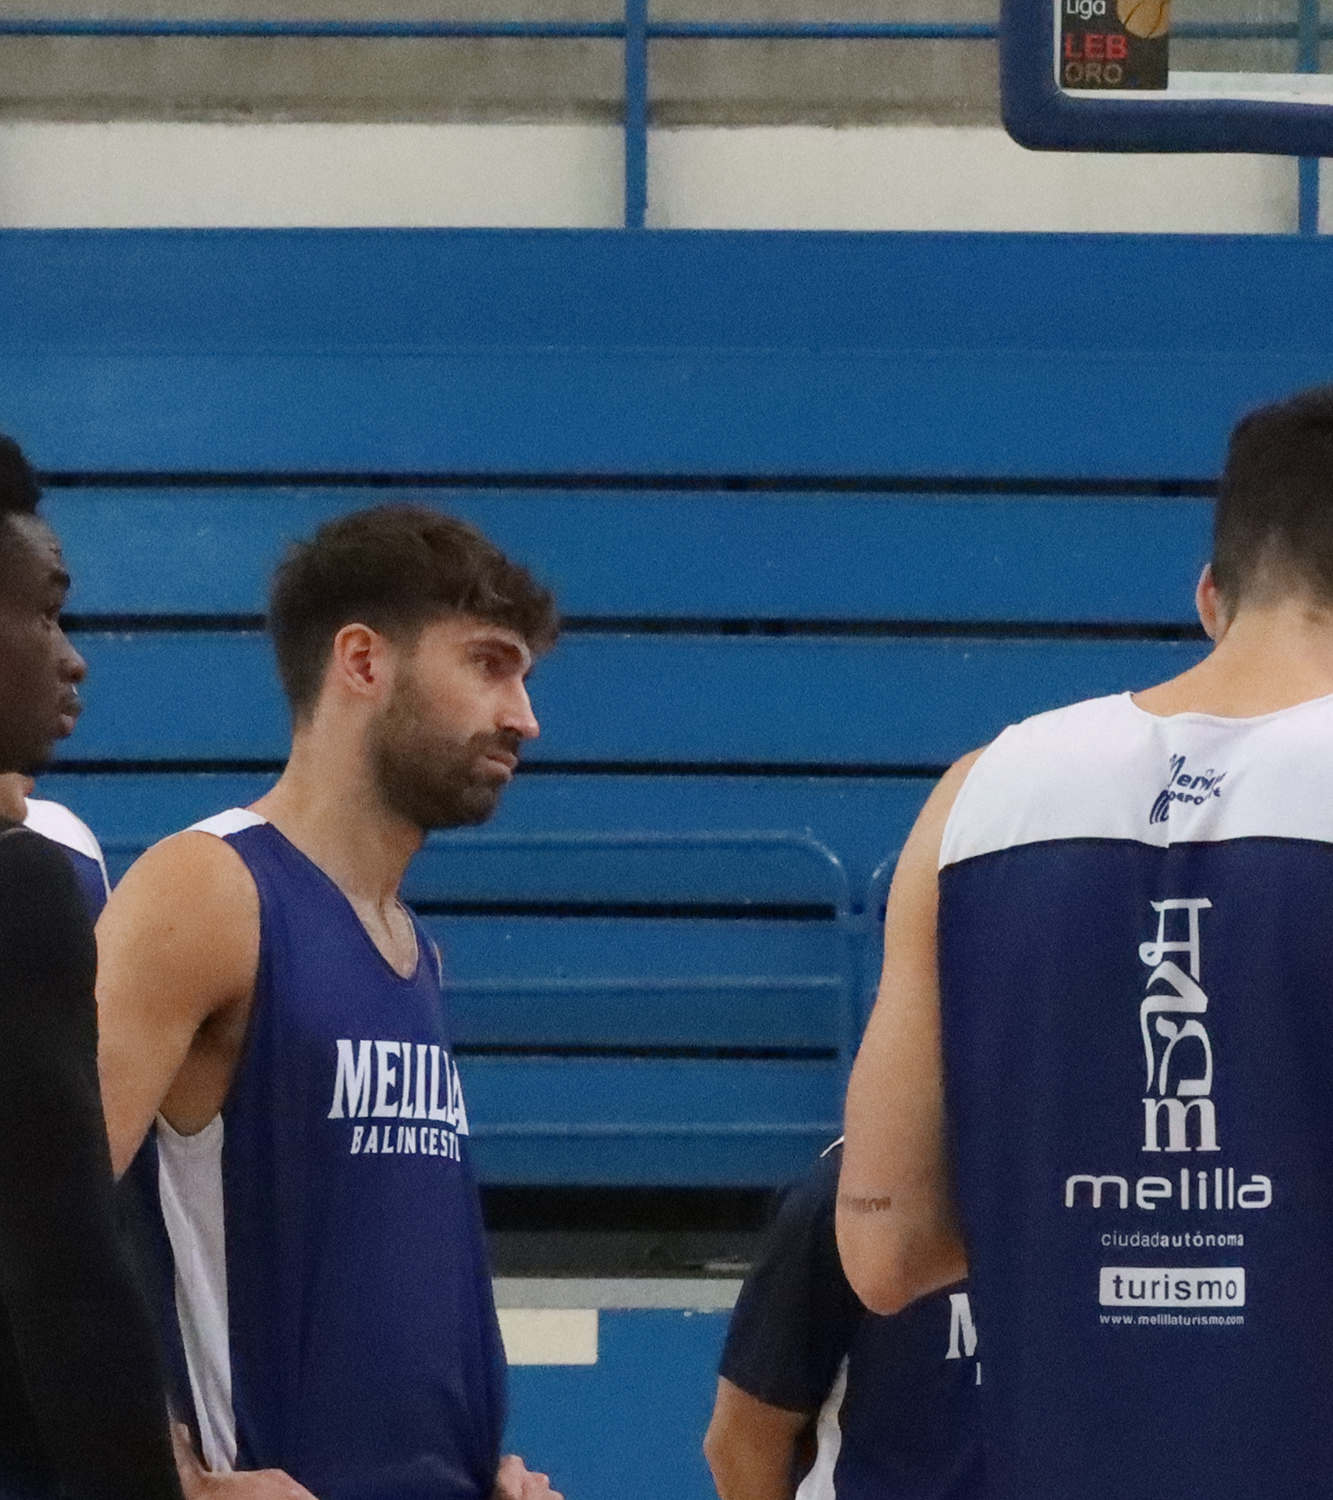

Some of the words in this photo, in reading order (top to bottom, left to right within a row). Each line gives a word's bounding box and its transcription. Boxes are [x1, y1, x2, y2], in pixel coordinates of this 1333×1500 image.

[1065, 33, 1128, 59] LEB
[1065, 62, 1123, 83] ORO
[1065, 1167, 1273, 1210] melilla
[1112, 1273, 1237, 1300] turismo
